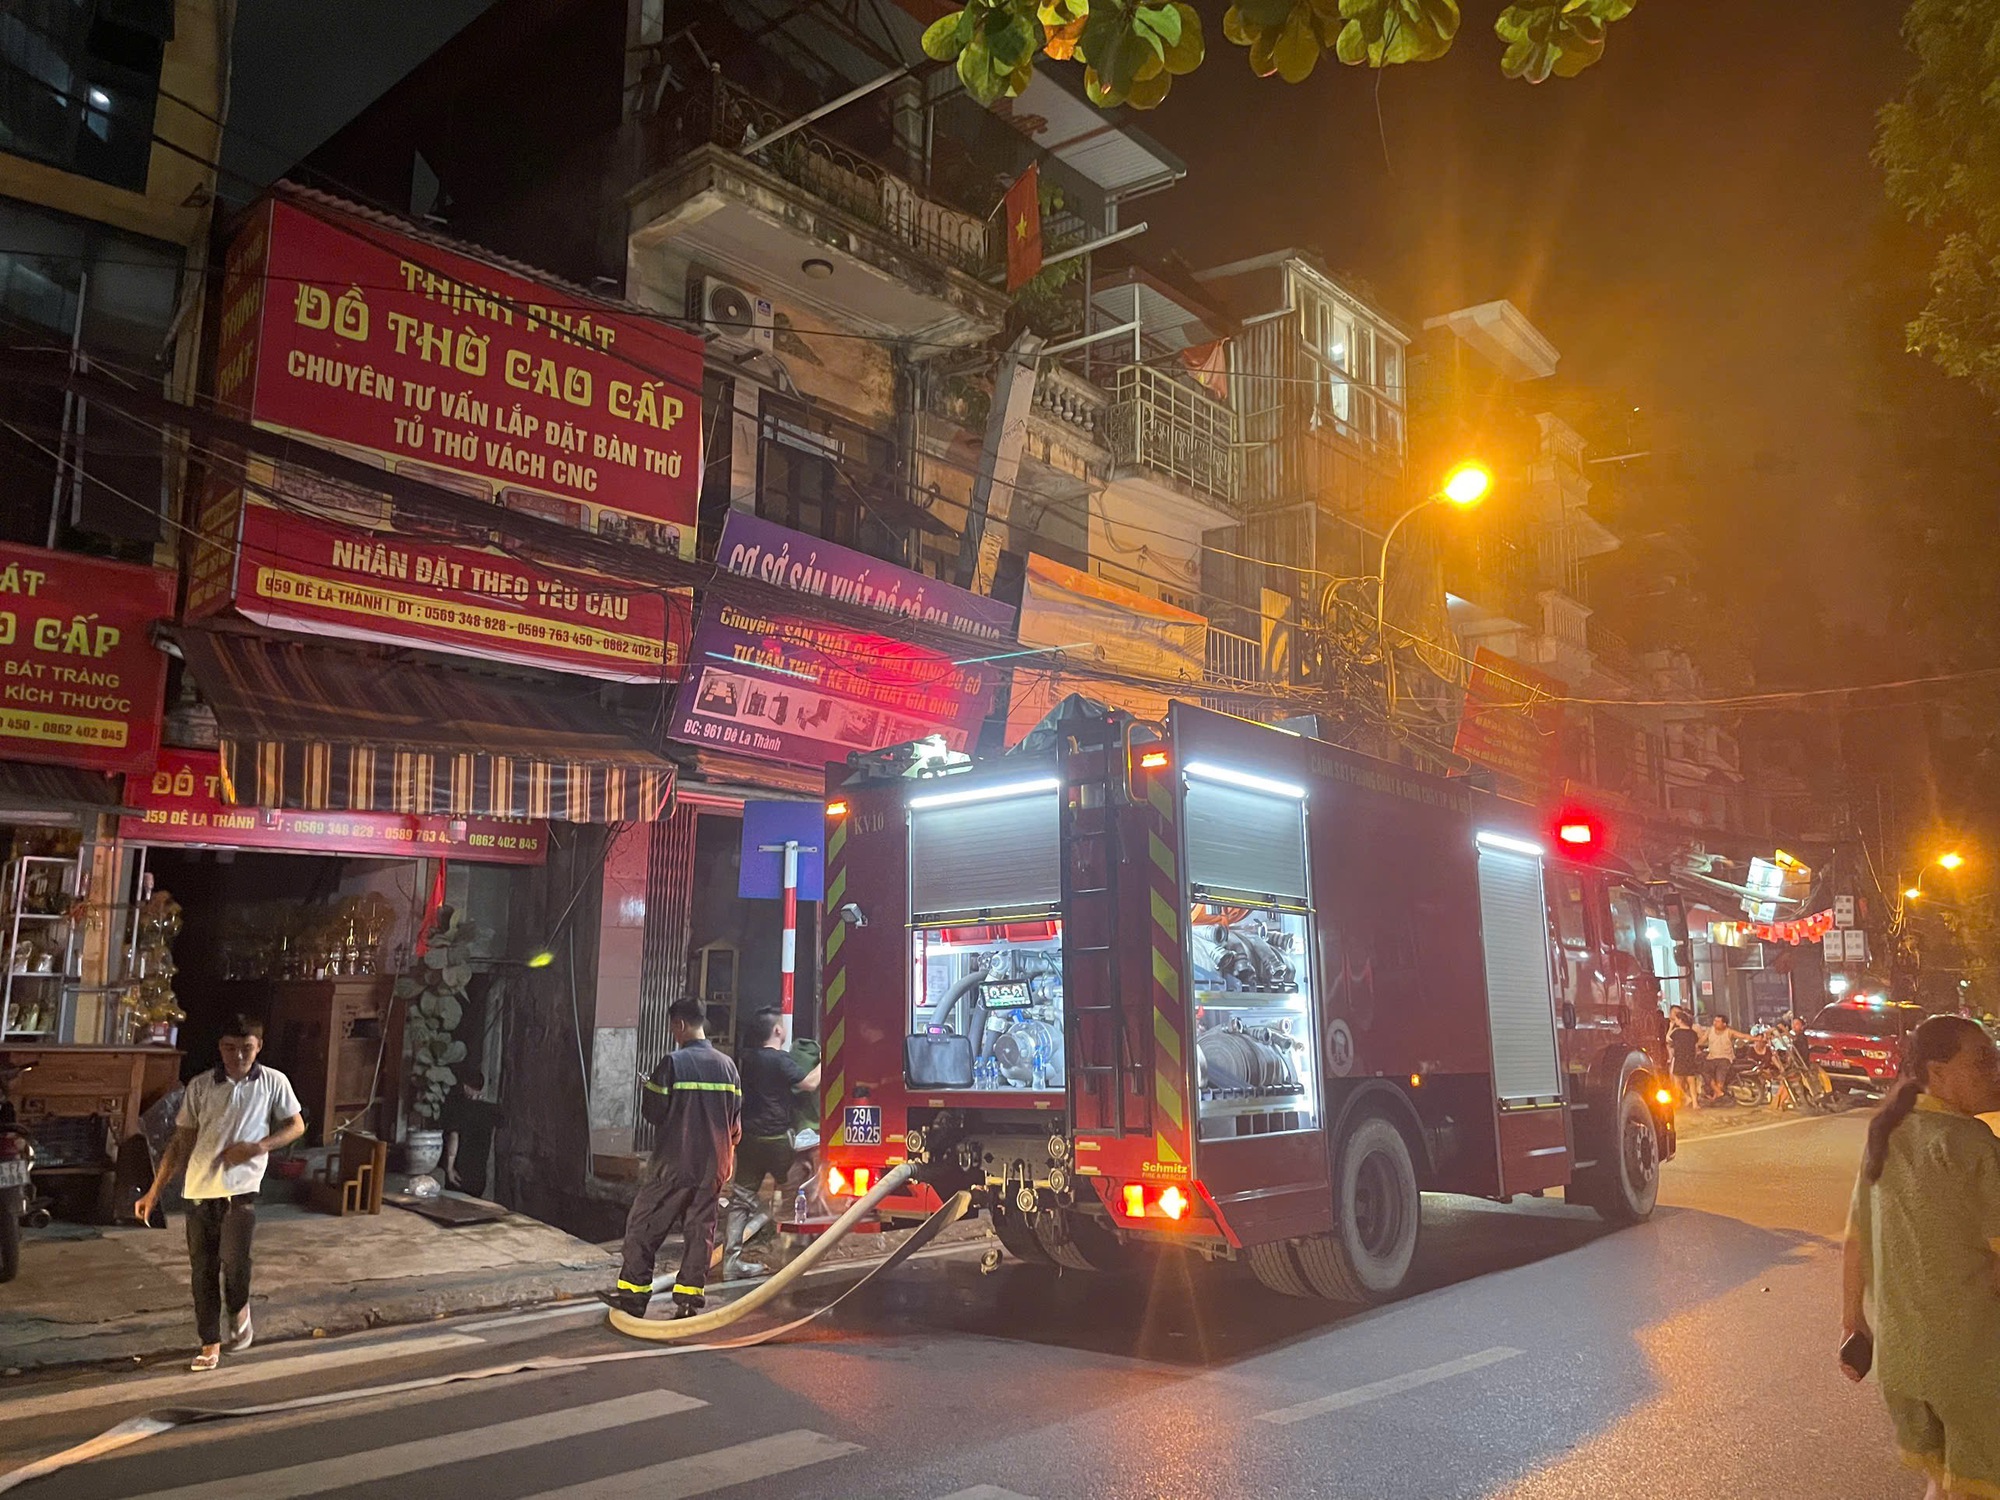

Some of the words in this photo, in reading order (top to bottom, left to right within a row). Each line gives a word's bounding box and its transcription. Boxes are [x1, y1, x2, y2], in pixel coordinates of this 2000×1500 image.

[400, 261, 513, 325] THỊNH
[527, 304, 615, 355] PHÁT
[294, 283, 370, 342] ĐỒ
[387, 312, 490, 377] THỜ
[505, 349, 592, 407] CAO
[607, 380, 684, 431] CẤP
[288, 349, 394, 402] CHUYÊN
[402, 381, 437, 411] TƯ
[440, 390, 489, 427] VẤN
[495, 402, 539, 439] LẮP
[545, 420, 587, 456] ĐẶT
[594, 434, 637, 466] BÀN
[643, 448, 682, 479] THỜ
[394, 414, 425, 447] TỦ
[432, 427, 479, 462] THỜ
[485, 440, 545, 480] VÁCH
[552, 459, 598, 492] CNC
[0, 562, 46, 597] ÁT
[415, 555, 464, 592] ĐẶT
[470, 567, 529, 602] THEO
[537, 579, 579, 611] YÊU
[728, 543, 760, 578] CƠ
[761, 542, 789, 587] SỞ
[790, 552, 828, 596] SẢN
[265, 577, 291, 593] 959
[317, 586, 333, 602] LA
[459, 612, 481, 627] 348
[484, 617, 506, 631] 828
[549, 628, 569, 642] 763
[573, 633, 592, 646] 450
[632, 643, 651, 657] 402
[33, 613, 120, 658] CẤP
[4, 660, 47, 679] BÁT
[52, 665, 120, 688] TRÀNG
[4, 683, 54, 704] KÍCH
[60, 690, 131, 713] THƯỚC
[7, 716, 30, 731] 450
[75, 725, 98, 738] 402
[101, 727, 123, 741] 845
[703, 723, 722, 740] 961
[723, 727, 738, 743] Đê
[739, 730, 751, 745] La
[753, 733, 781, 751] Thành
[152, 764, 194, 797] ĐỒ
[192, 813, 207, 826] LA
[327, 822, 349, 836] 348
[352, 824, 374, 838] 828
[385, 827, 413, 841] 0589
[416, 830, 436, 843] 763
[469, 834, 495, 847] 0862
[497, 836, 516, 849] 402
[519, 838, 538, 850] 845
[845, 1126, 880, 1143] 026.25
[852, 1108, 872, 1125] 29A
[1142, 1161, 1187, 1173] Schmitz
